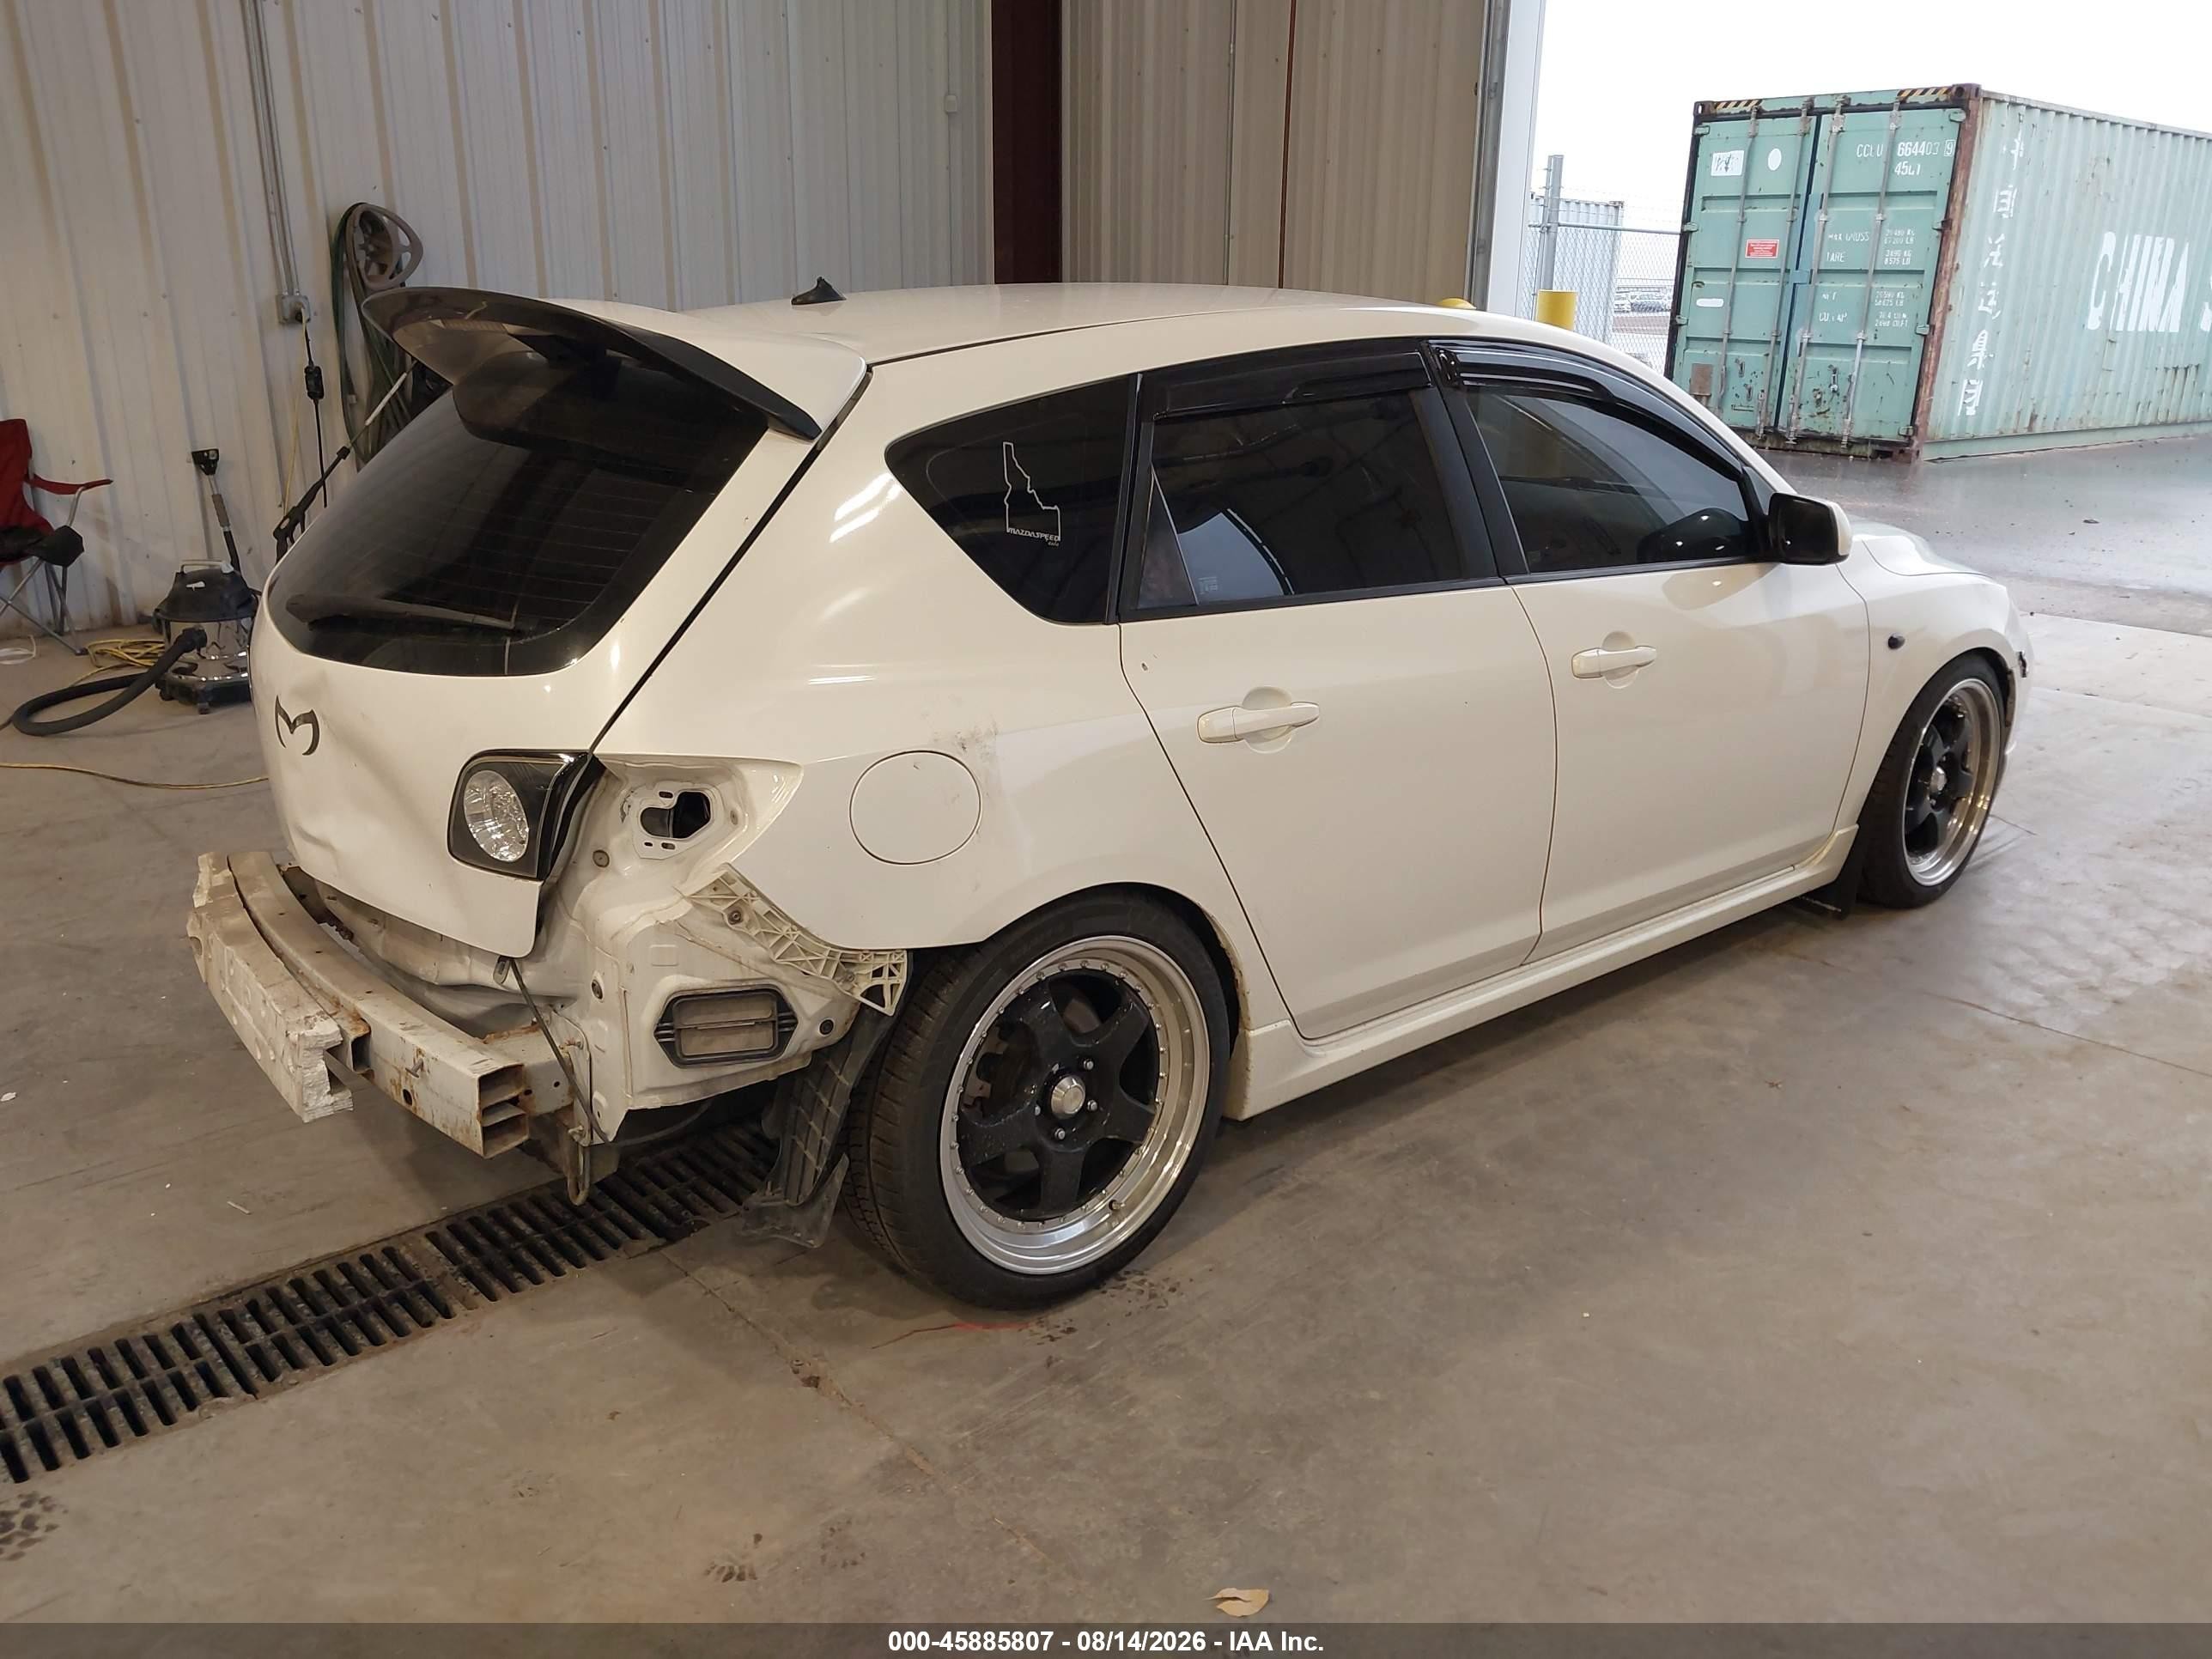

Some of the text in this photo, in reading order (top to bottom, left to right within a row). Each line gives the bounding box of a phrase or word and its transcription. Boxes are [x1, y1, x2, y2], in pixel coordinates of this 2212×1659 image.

[1896, 141, 1940, 157] 664403
[1945, 140, 1955, 156] 9
[2087, 231, 2189, 332] CHINA
[1008, 527, 1060, 542] MAZDASPEED
